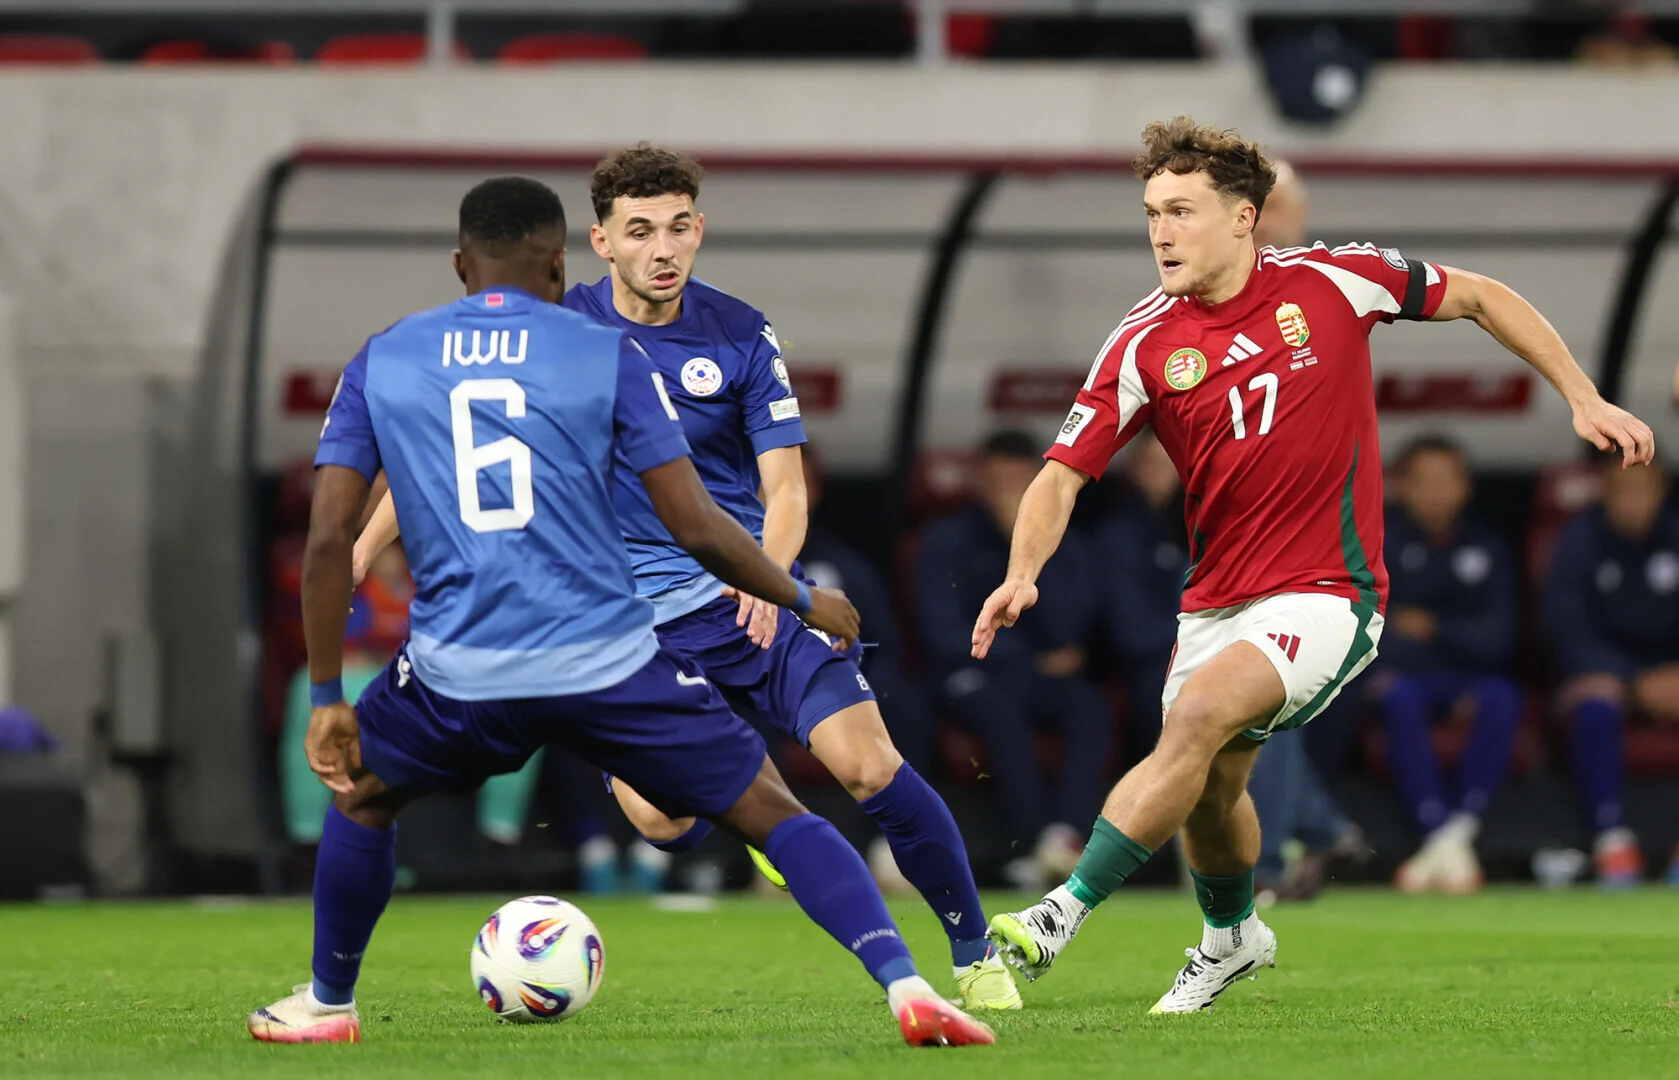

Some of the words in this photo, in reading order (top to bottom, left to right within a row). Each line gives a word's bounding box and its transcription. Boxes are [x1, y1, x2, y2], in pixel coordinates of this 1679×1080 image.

[442, 329, 529, 367] IWU
[1228, 372, 1279, 440] 17
[449, 377, 535, 534] 6
